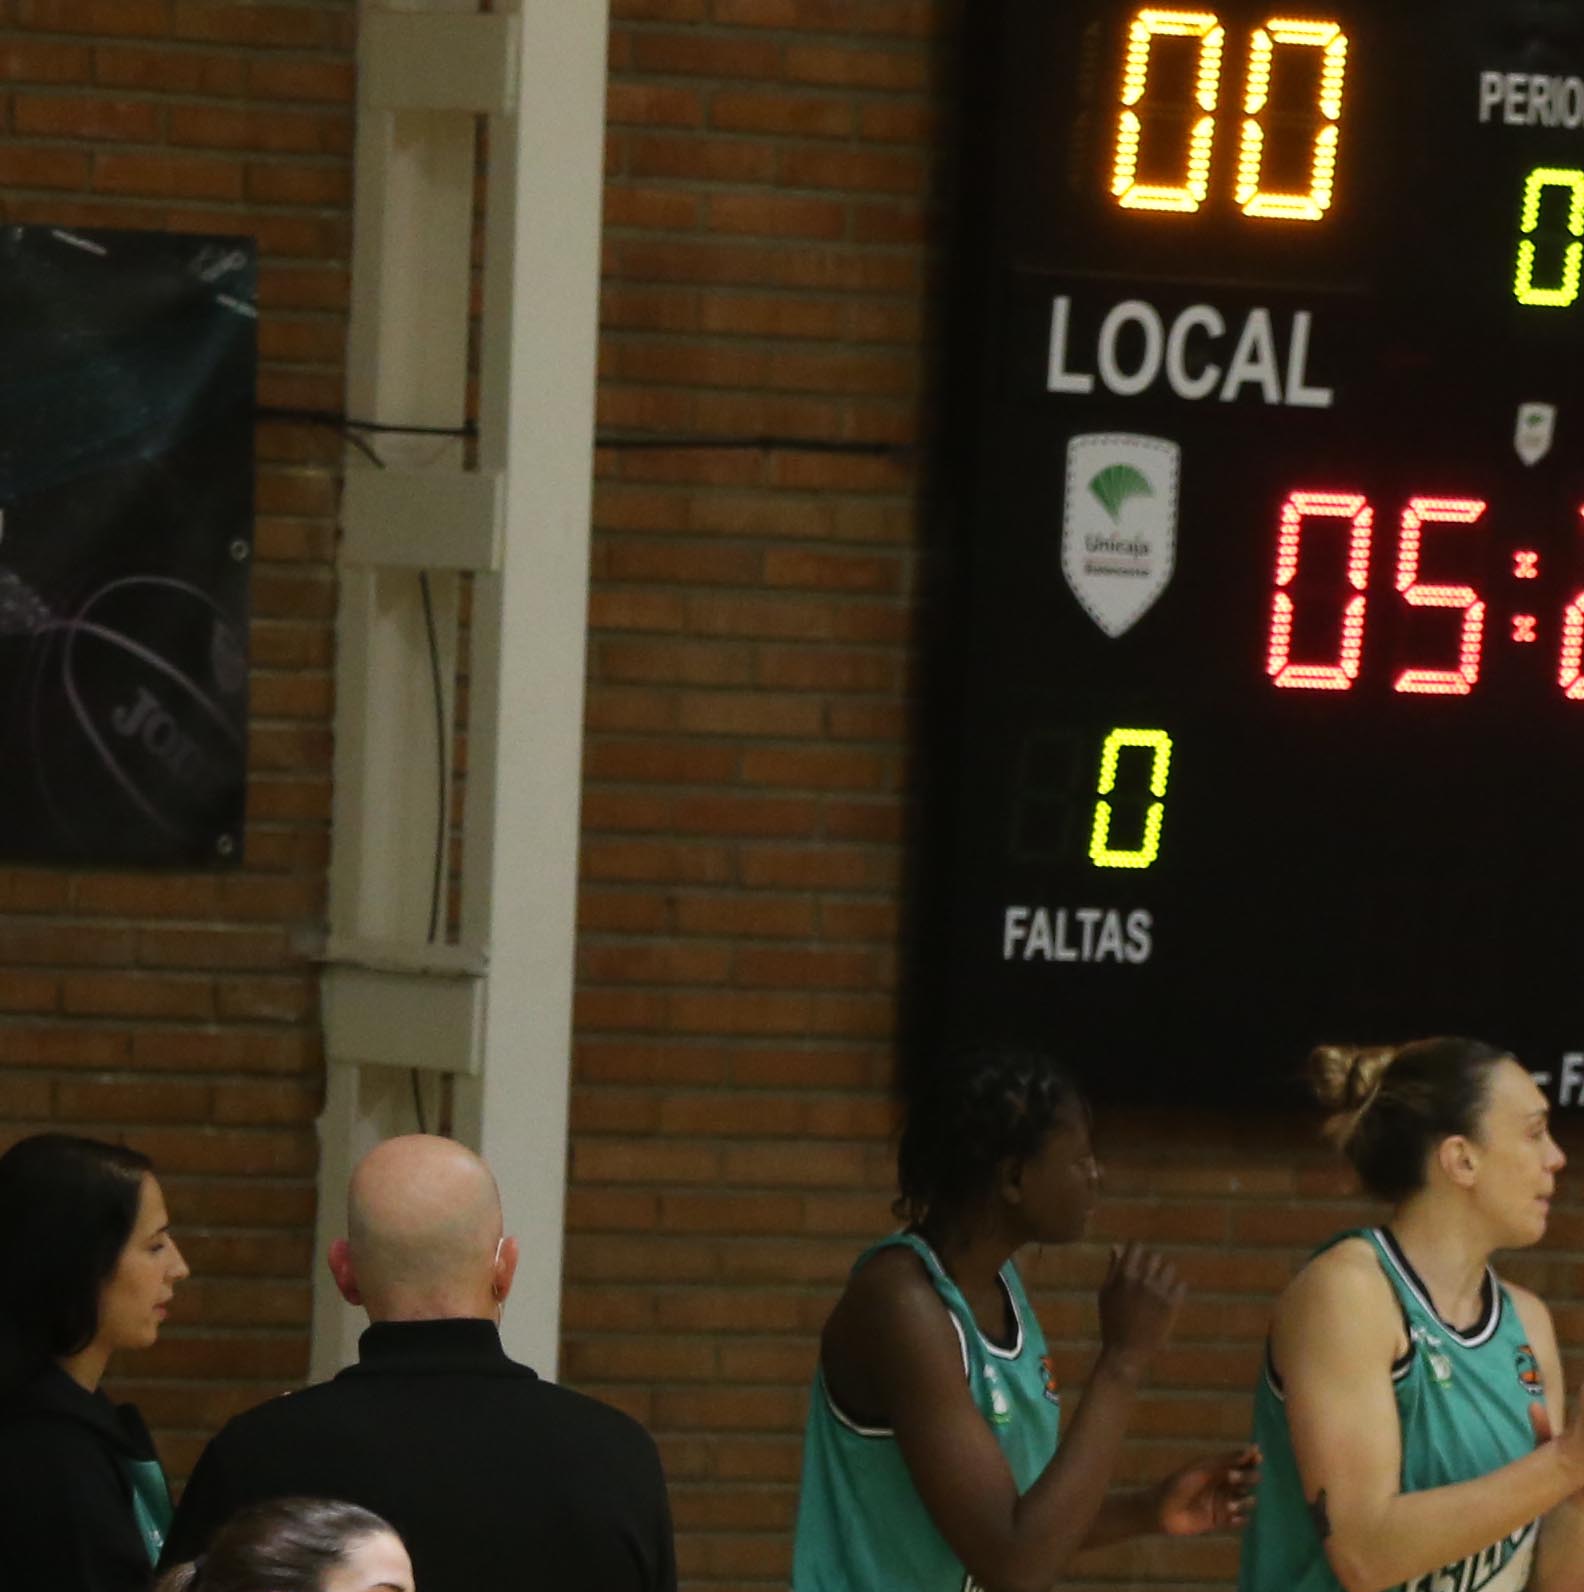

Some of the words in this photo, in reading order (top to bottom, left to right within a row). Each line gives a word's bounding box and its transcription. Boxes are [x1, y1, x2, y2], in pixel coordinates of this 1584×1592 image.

[1112, 8, 1347, 220] 00
[1046, 297, 1333, 407] LOCAL
[1088, 728, 1172, 868] 0
[1003, 906, 1152, 964] FALTAS
